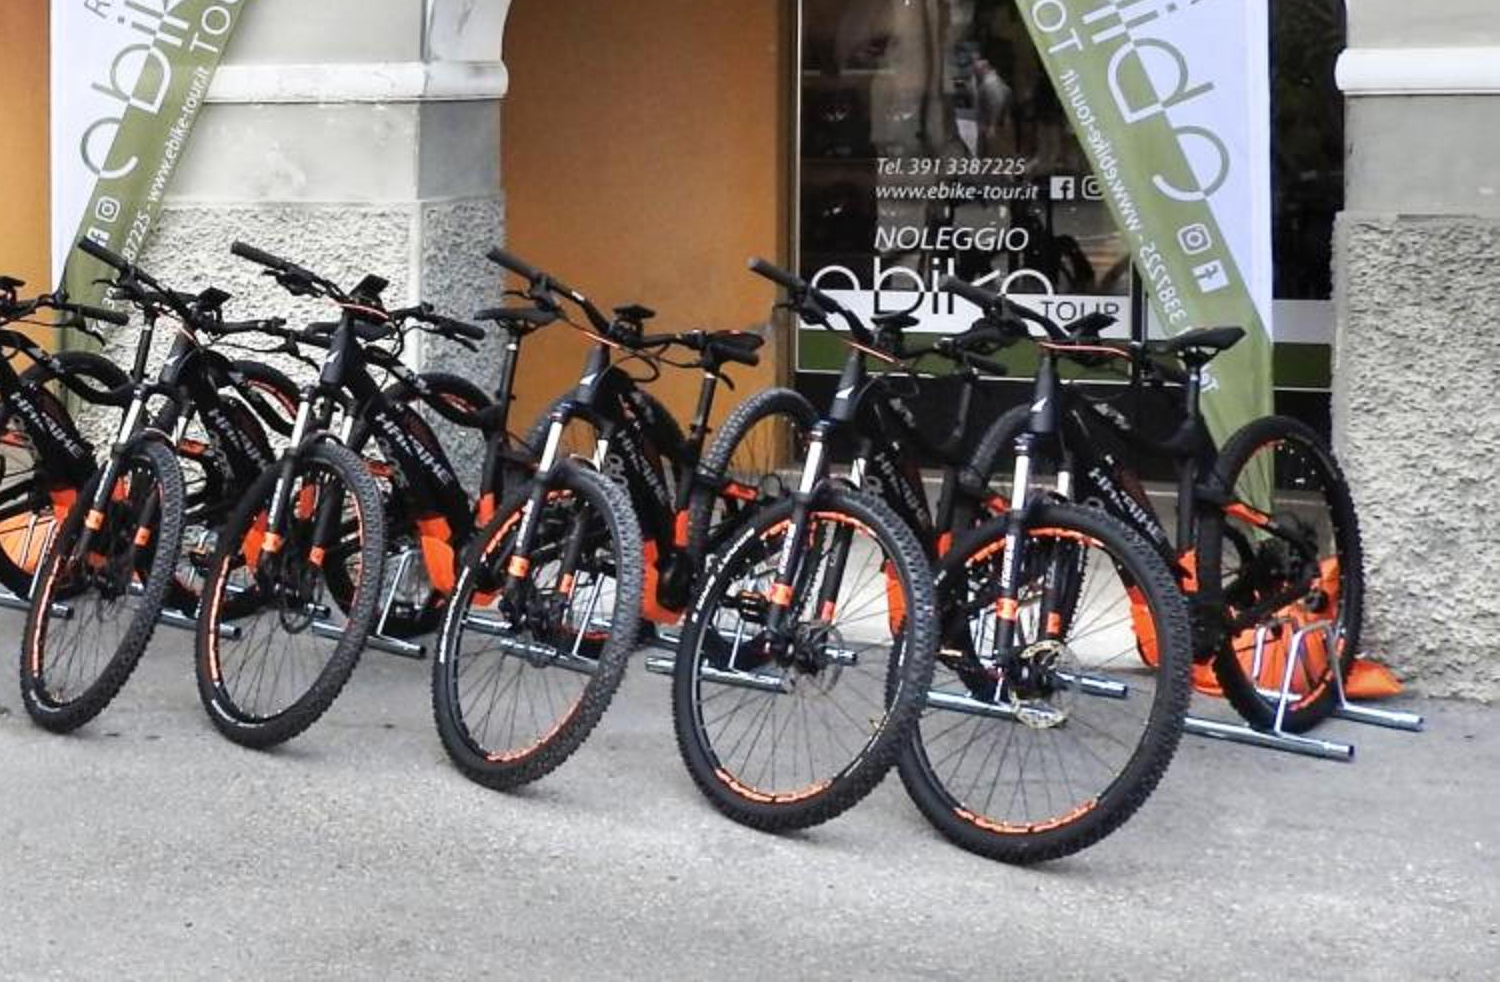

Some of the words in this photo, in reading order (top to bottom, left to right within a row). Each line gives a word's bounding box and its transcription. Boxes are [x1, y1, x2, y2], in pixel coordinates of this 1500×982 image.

[907, 157, 941, 176] 391
[945, 157, 1027, 176] 3387225
[875, 182, 1039, 200] www.ebike-tour.it
[873, 225, 1030, 251] NOLEGGIO
